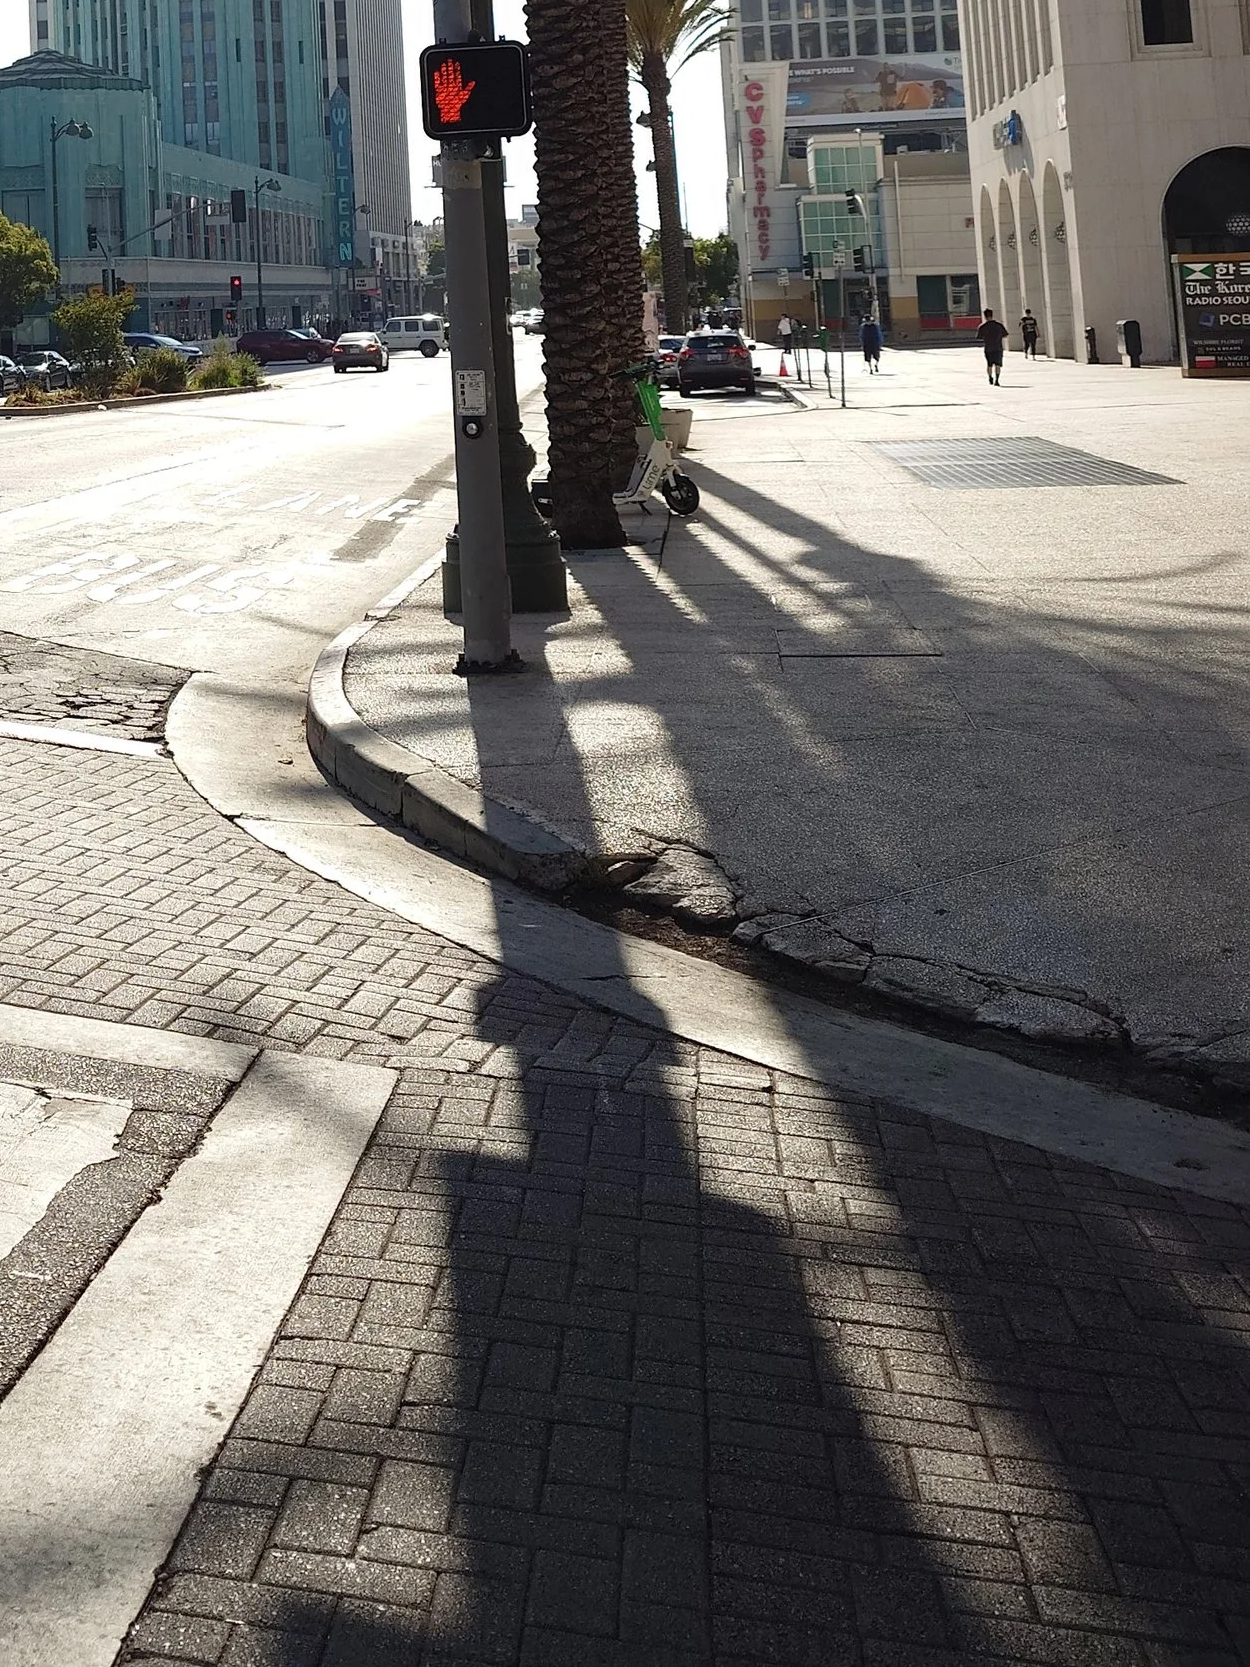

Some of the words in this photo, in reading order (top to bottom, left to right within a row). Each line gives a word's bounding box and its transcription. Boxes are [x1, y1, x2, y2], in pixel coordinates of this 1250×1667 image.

[794, 68, 821, 77] WHAT'S
[822, 66, 855, 75] POSSIBLE
[745, 82, 767, 147] CVS
[331, 107, 353, 261] WILTERN
[752, 147, 771, 261] pharmacy
[1185, 282, 1212, 295] The
[1185, 296, 1222, 306] RADIO
[642, 465, 660, 490] Lime
